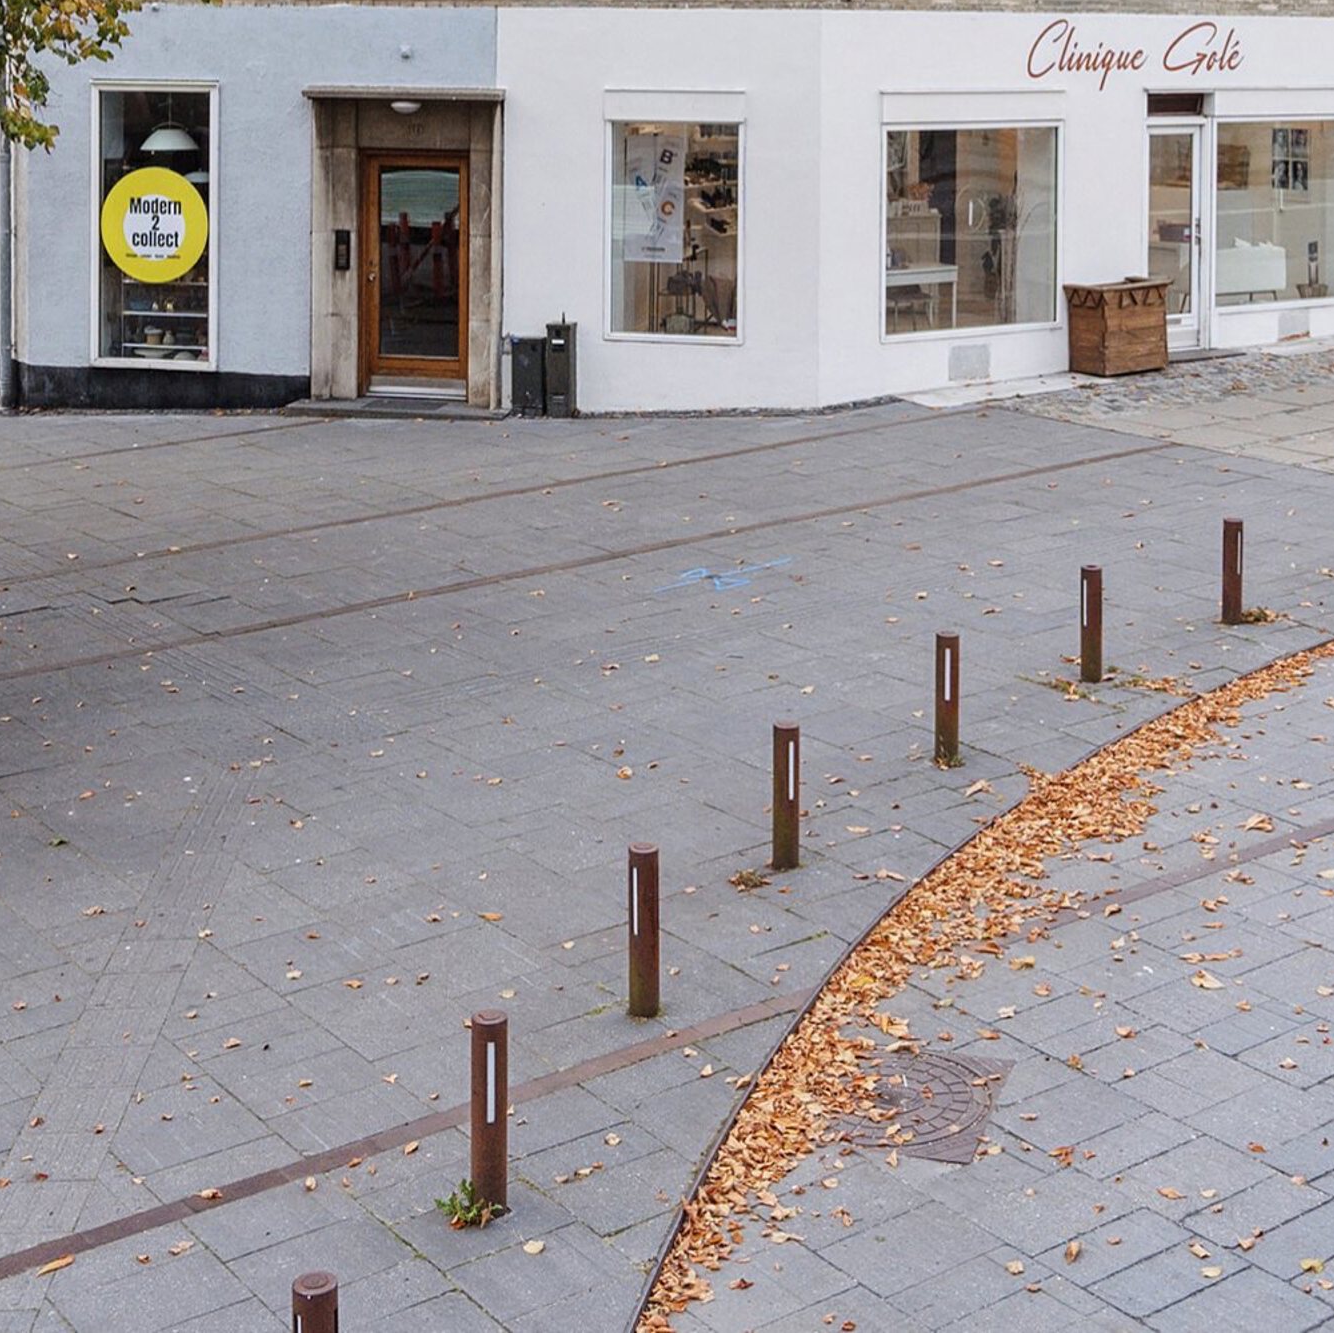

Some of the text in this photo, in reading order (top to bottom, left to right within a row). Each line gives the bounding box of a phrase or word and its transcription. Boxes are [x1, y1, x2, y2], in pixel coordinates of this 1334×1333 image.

[1028, 19, 1244, 90] Clinique Golé
[129, 197, 182, 215] Modern
[151, 215, 160, 231] 2
[132, 231, 179, 248] collect
